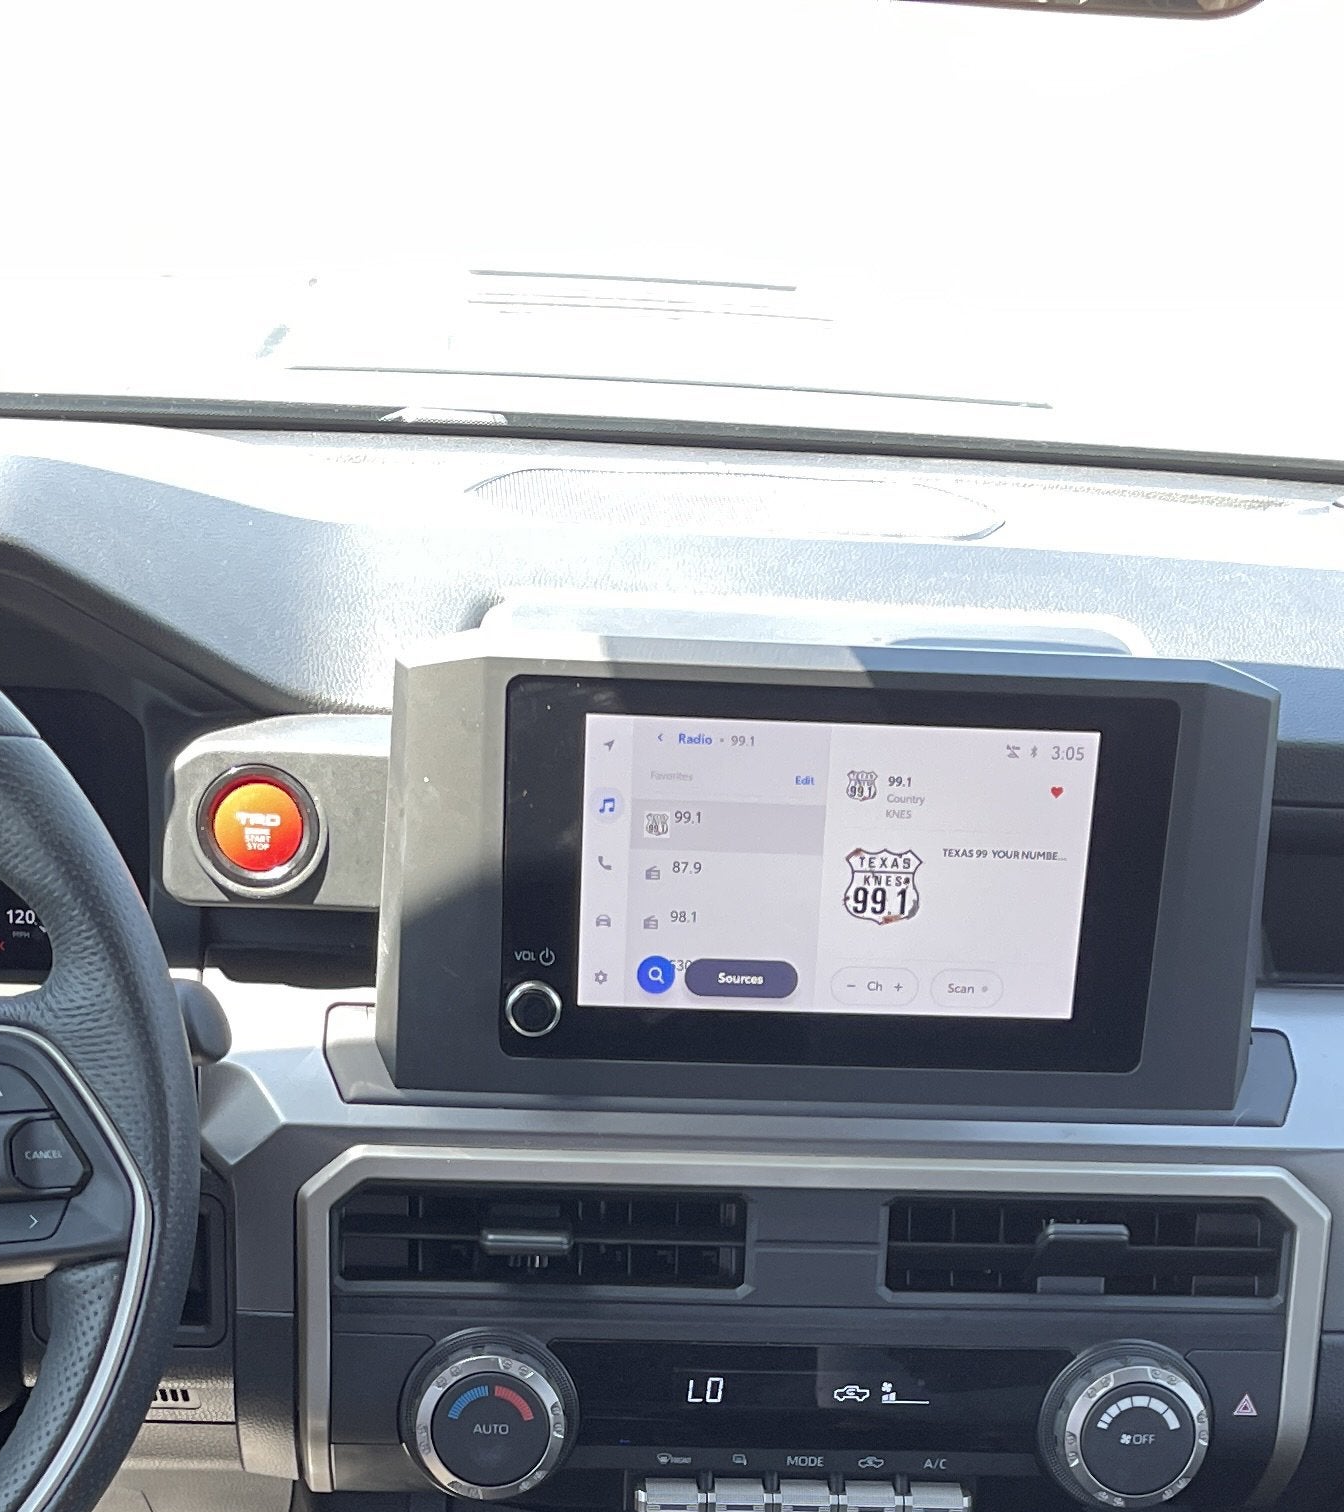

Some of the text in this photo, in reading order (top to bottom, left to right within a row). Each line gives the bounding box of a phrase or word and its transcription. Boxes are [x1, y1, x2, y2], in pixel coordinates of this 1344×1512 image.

[677, 732, 755, 747] Radio 99.1
[1051, 746, 1085, 760] 3:05
[795, 775, 815, 786] Edit
[887, 776, 912, 788] 99.1
[886, 793, 925, 806] Country
[674, 811, 702, 824] 99.1
[885, 809, 912, 819] KNES
[942, 848, 974, 859] TEXAS
[975, 849, 988, 859] 99
[991, 850, 1020, 860] YOUR
[672, 861, 702, 874] 87.9
[858, 856, 911, 870] TEXAS
[863, 875, 903, 887] KNES
[852, 886, 907, 916] 99.1
[6, 910, 36, 925] 120
[670, 910, 697, 923] 98.1
[514, 950, 536, 962] VOL
[718, 972, 764, 985] Sources
[867, 980, 883, 992] Ch
[947, 983, 975, 995] Scan
[24, 1149, 63, 1160] CANCEL
[472, 1423, 509, 1436] AUTO
[1132, 1433, 1156, 1446] OFF
[786, 1455, 824, 1467] MODE
[923, 1458, 948, 1470] A/C
